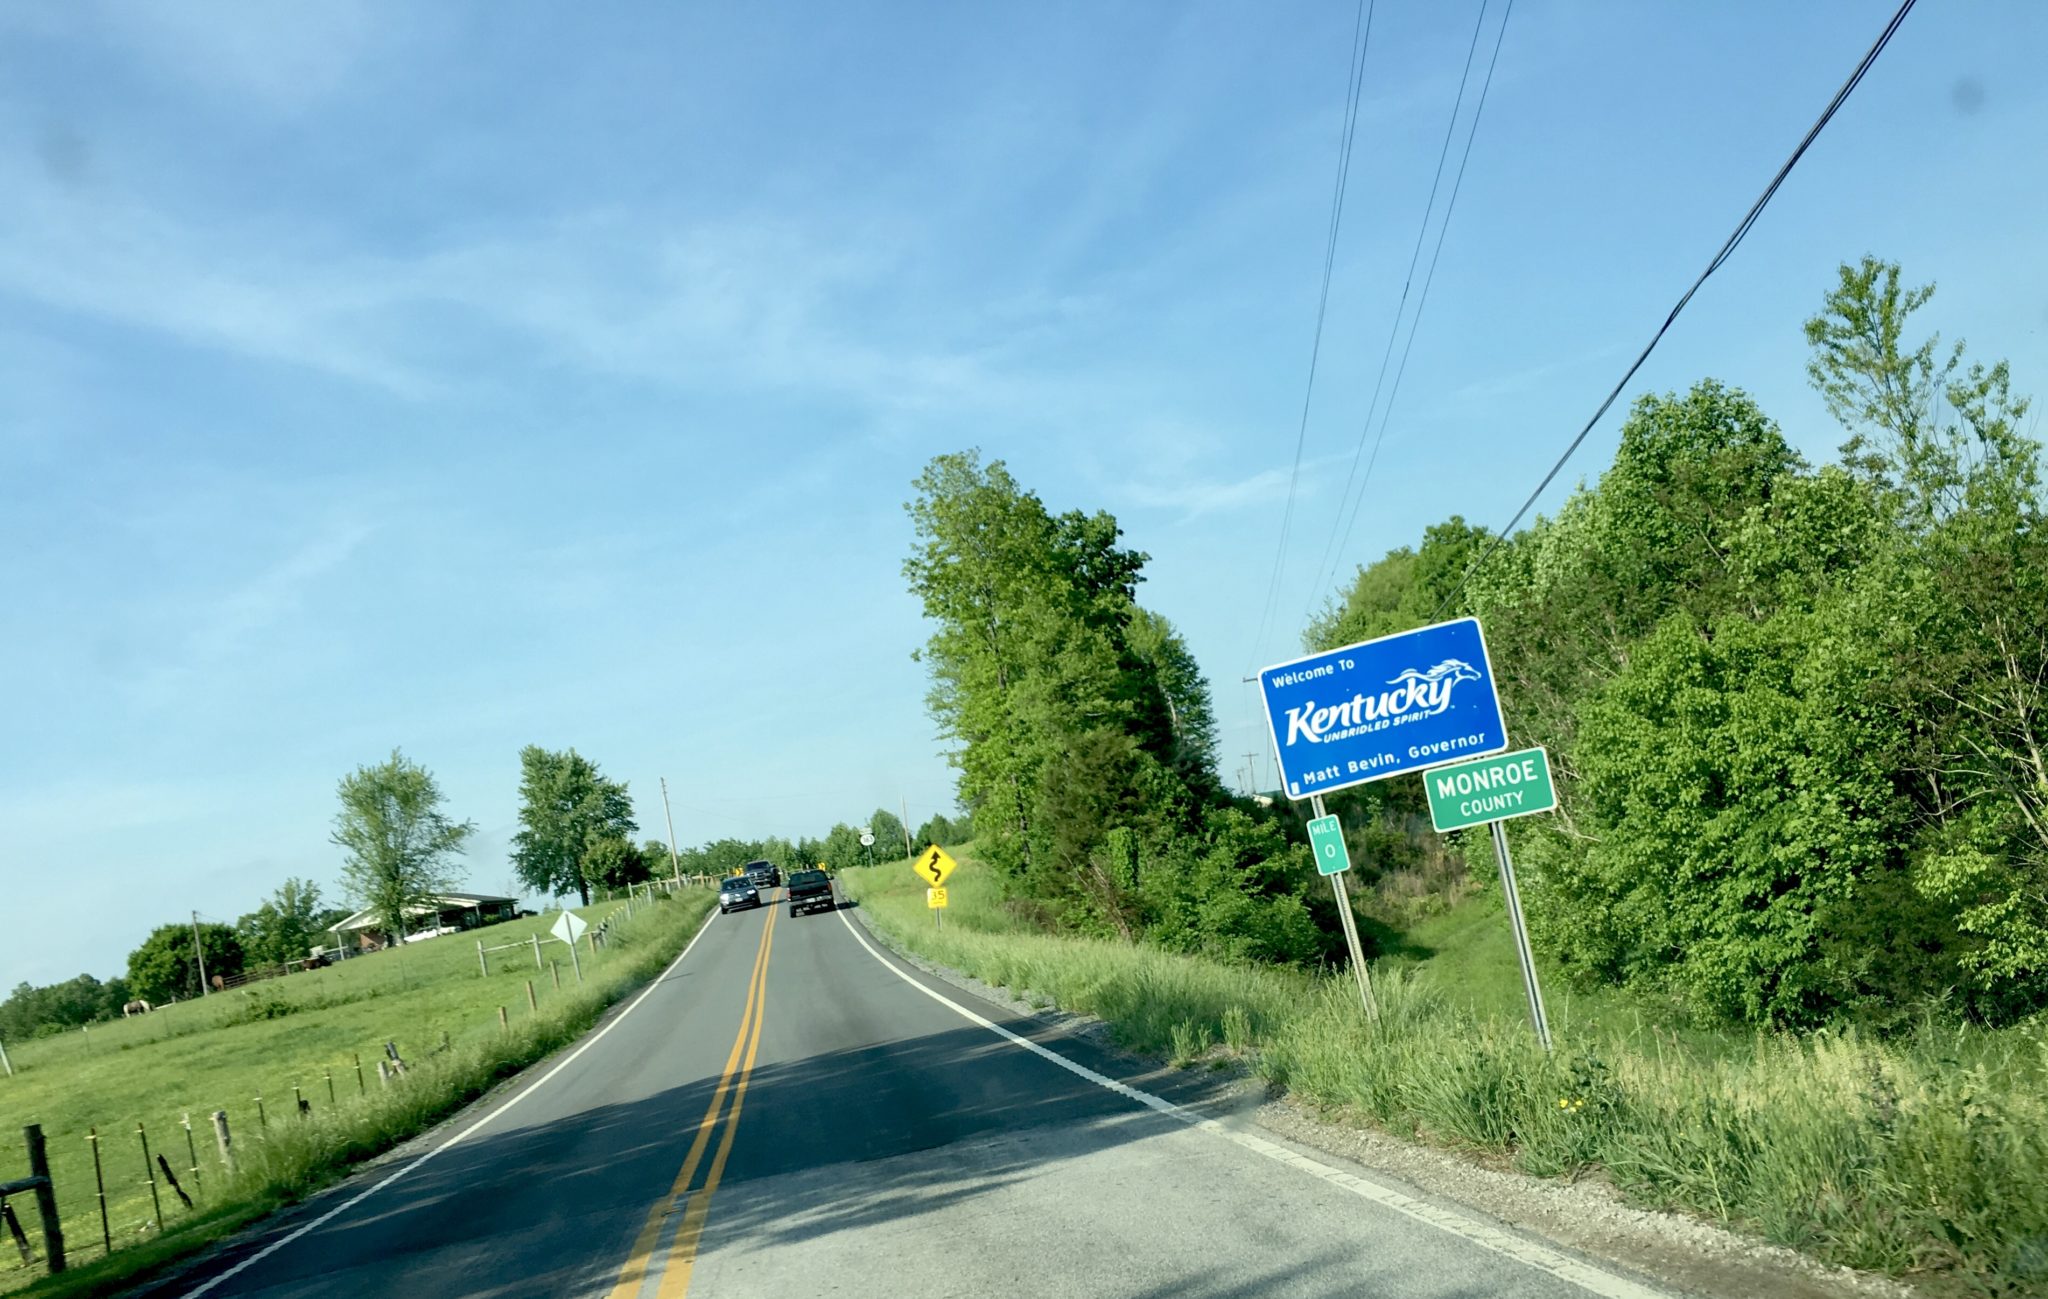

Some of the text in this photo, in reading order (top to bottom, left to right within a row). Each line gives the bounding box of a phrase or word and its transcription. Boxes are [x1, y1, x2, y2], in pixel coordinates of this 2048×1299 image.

[1272, 659, 1355, 688] Welcome To
[1285, 677, 1453, 747] Kentucky
[1323, 710, 1430, 743] UNBRIDLED SPIRIT
[1303, 733, 1485, 785] Matt Bevin, Governor
[1437, 760, 1538, 799] MONROE
[1461, 791, 1524, 817] COUNTY
[1312, 822, 1336, 836] MILE
